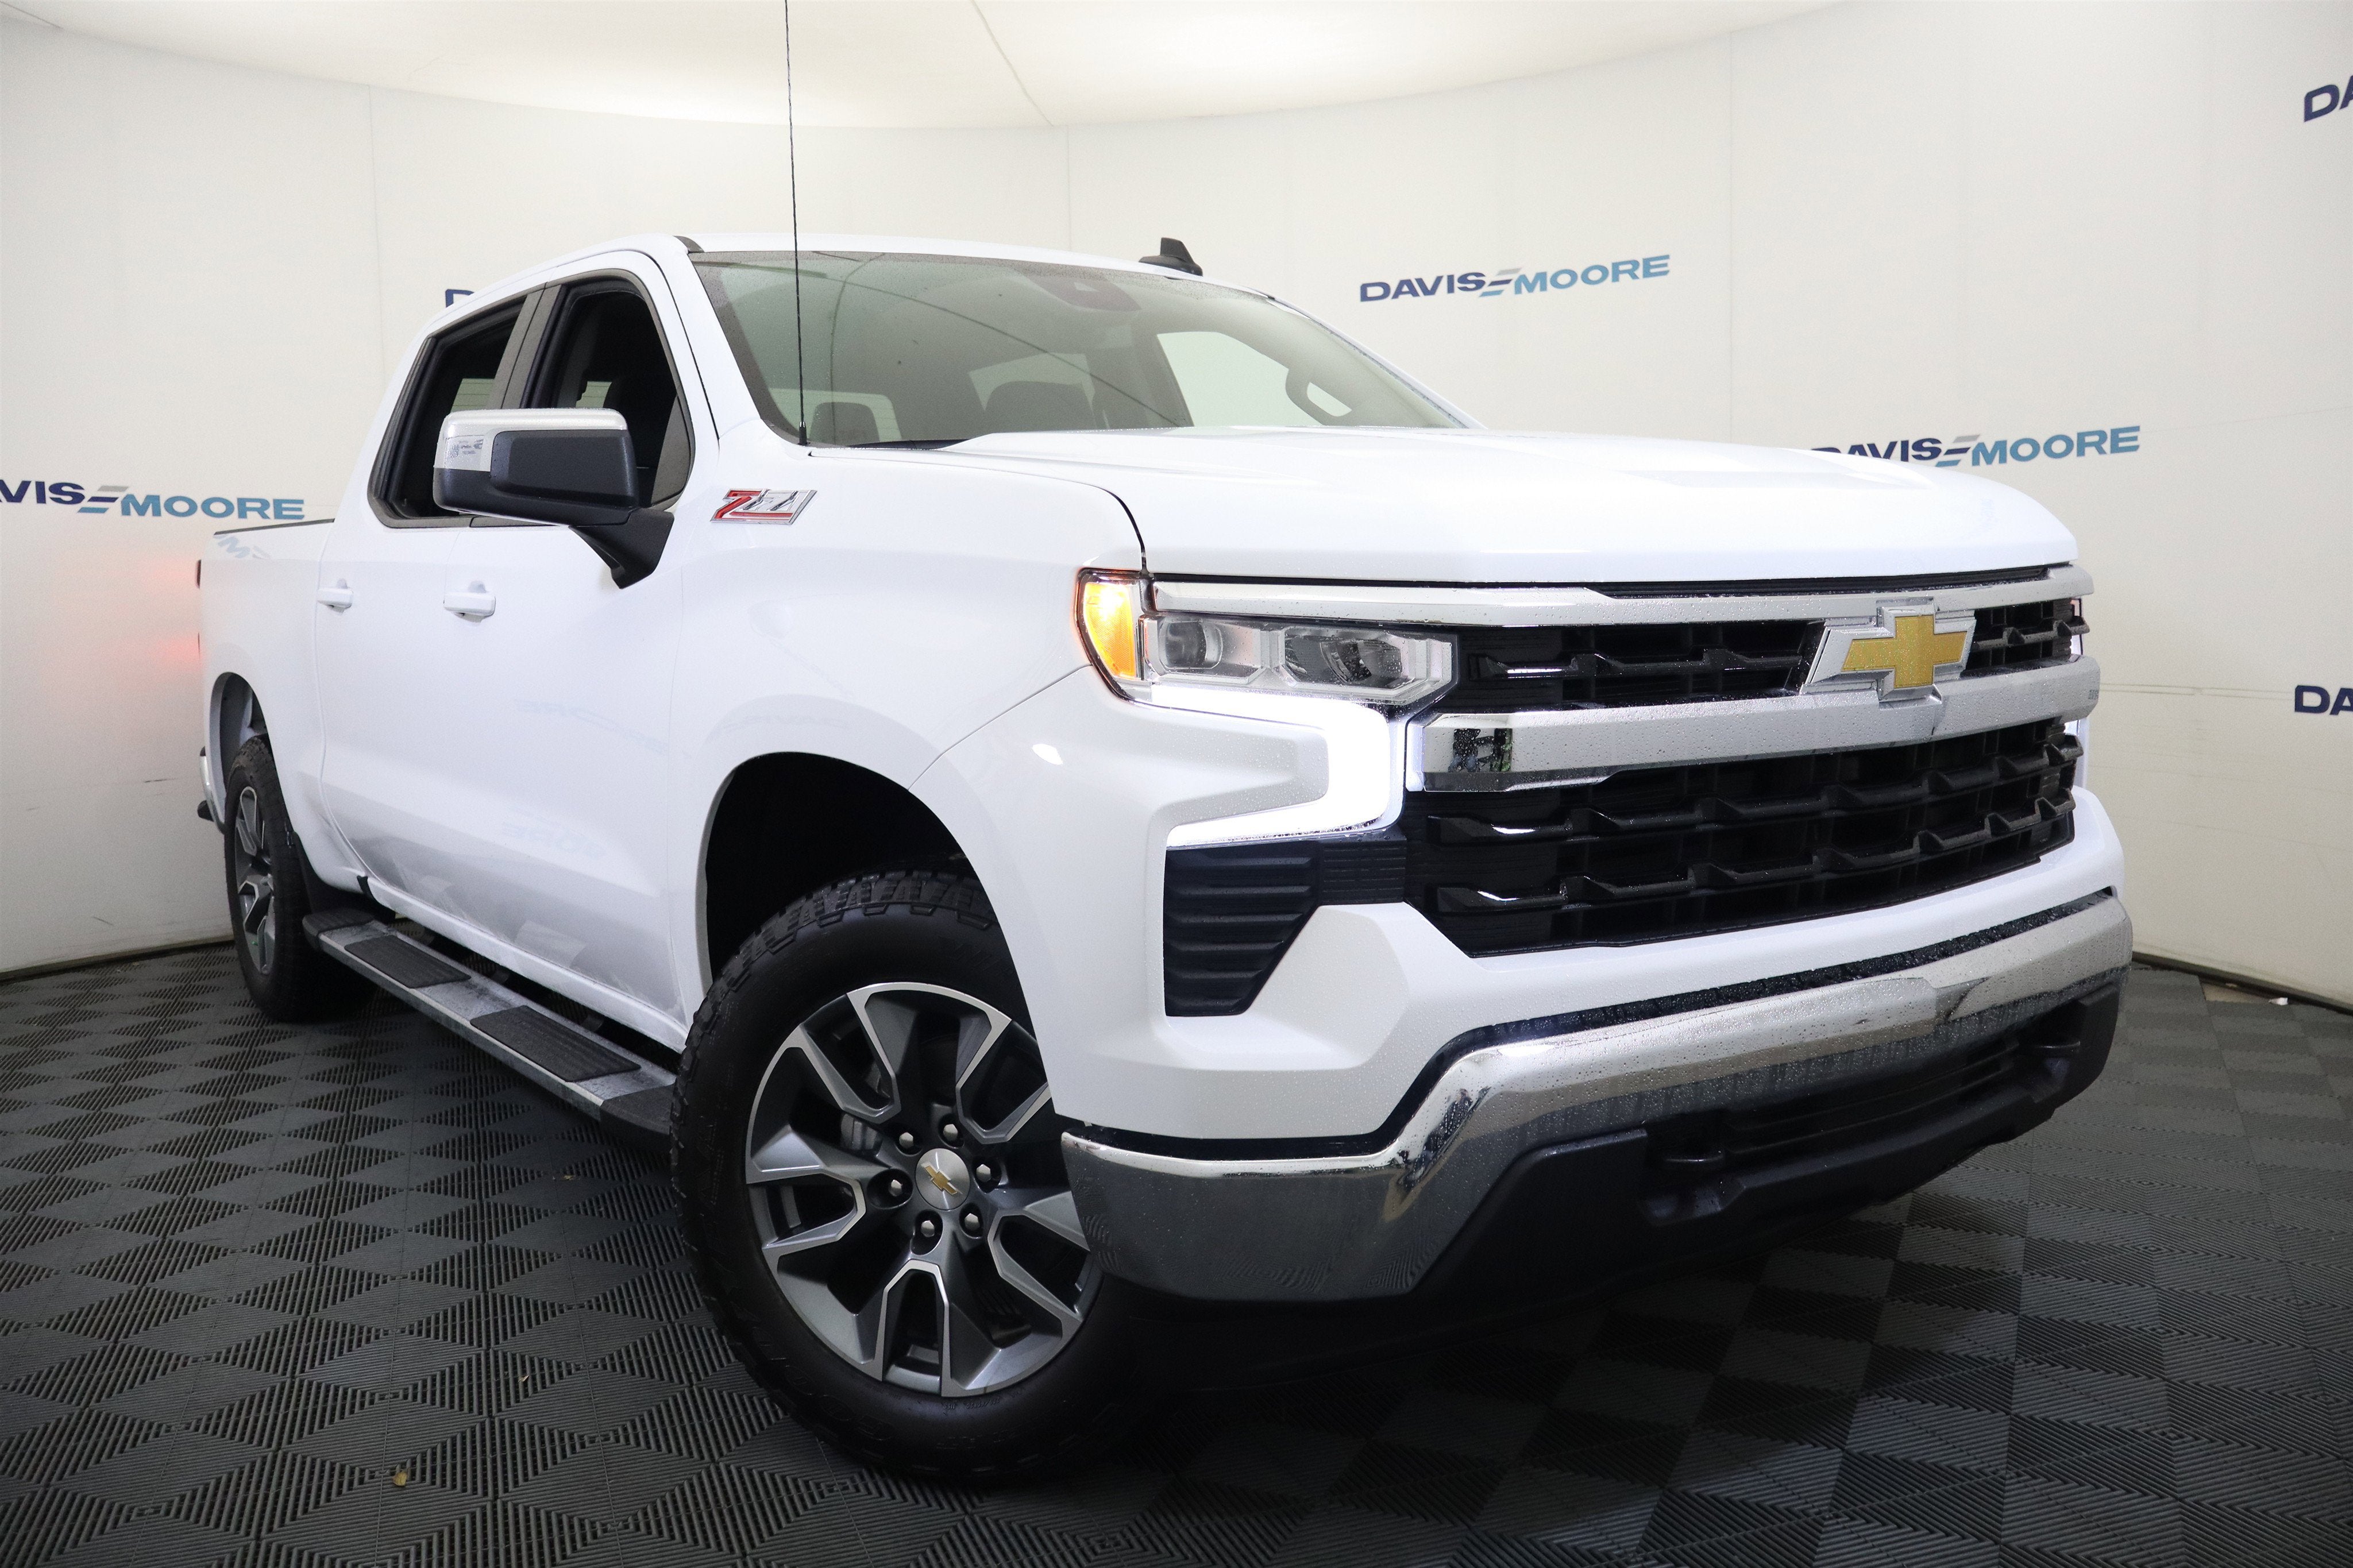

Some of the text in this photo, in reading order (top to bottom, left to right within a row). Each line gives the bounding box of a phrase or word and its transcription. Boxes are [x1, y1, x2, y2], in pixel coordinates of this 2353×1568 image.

[1360, 254, 1670, 302] DAVIS MOORE
[1811, 426, 2140, 466] VIS MOORE
[0, 479, 304, 520] VIS MOORE
